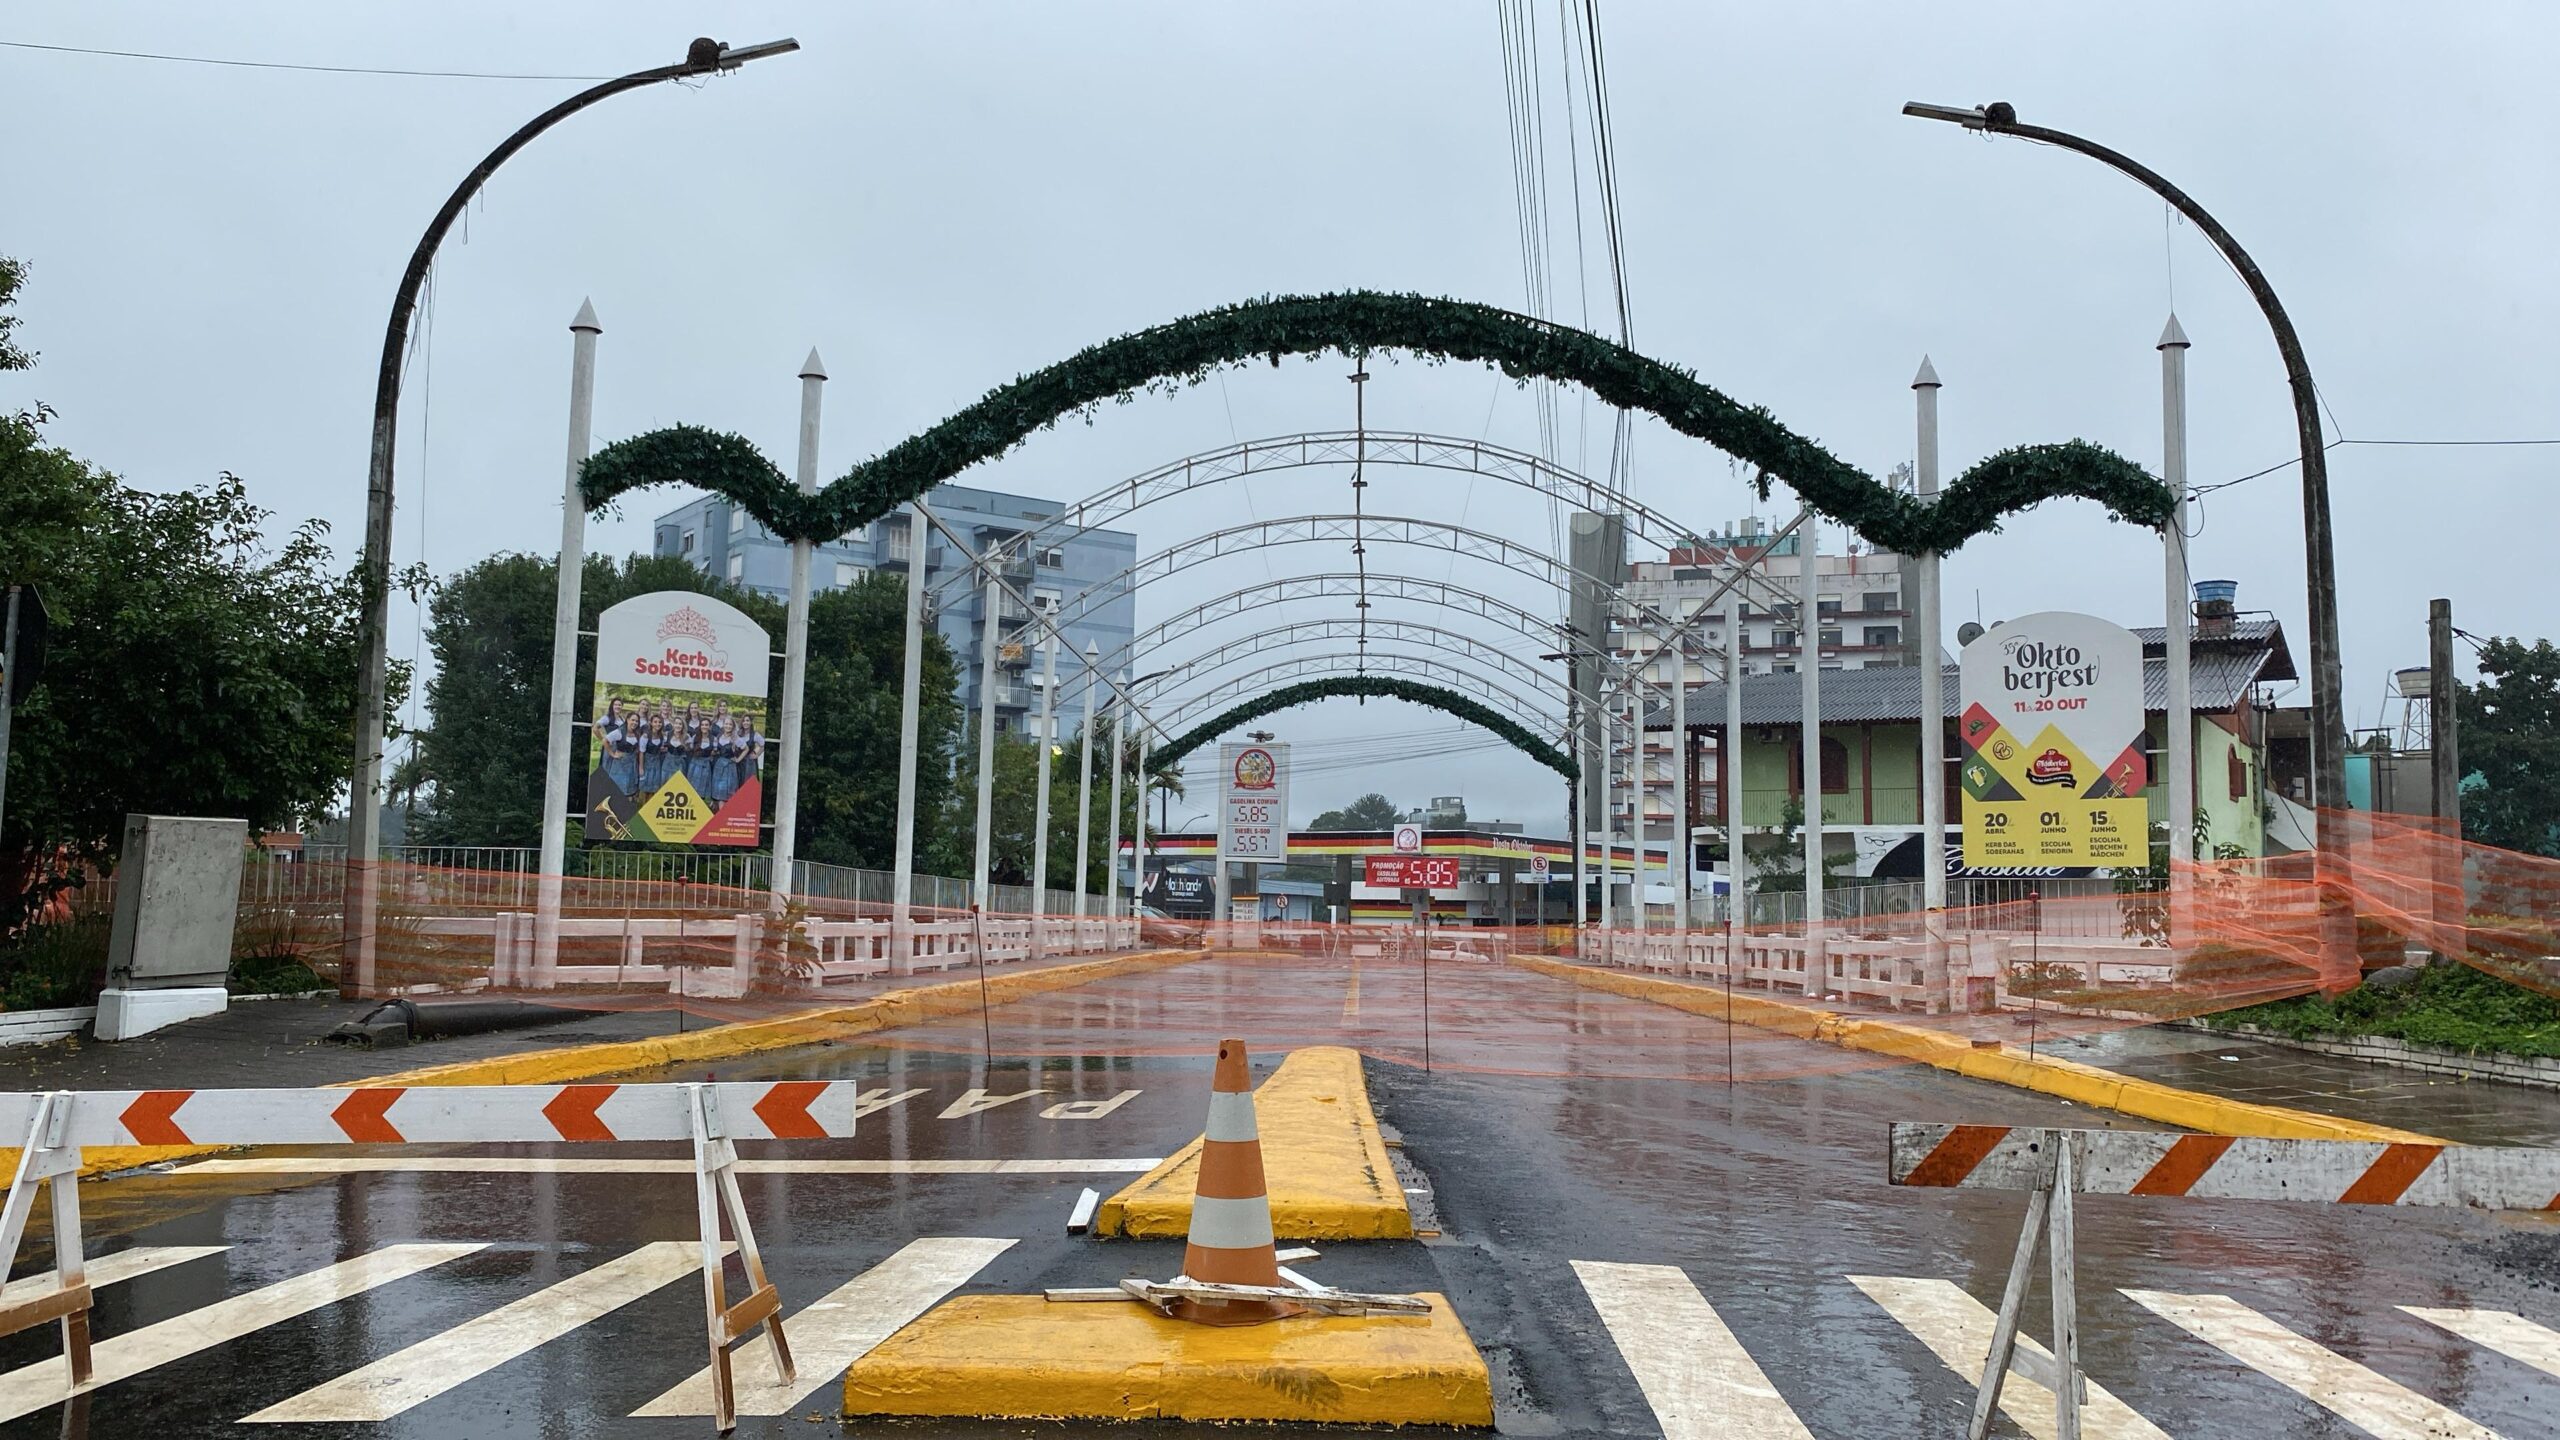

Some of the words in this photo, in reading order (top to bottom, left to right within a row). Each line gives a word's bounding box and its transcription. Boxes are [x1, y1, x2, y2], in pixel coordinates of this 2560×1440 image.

[666, 648, 708, 667] Kerb
[2016, 642, 2081, 671] Okto
[635, 657, 733, 683] Soberanas
[2003, 663, 2100, 698] berfest
[2014, 702, 2026, 712] 11
[2035, 700, 2054, 711] 20
[2057, 698, 2088, 710] OUT
[664, 791, 689, 808] 20
[656, 807, 697, 821] ABRIL
[1239, 805, 1268, 822] 5,85
[1985, 813, 2008, 827] 20
[2040, 811, 2060, 826] 01
[2089, 810, 2108, 825] 15
[1371, 861, 1405, 871] PROMOÇÃO
[1410, 861, 1453, 886] 5,85
